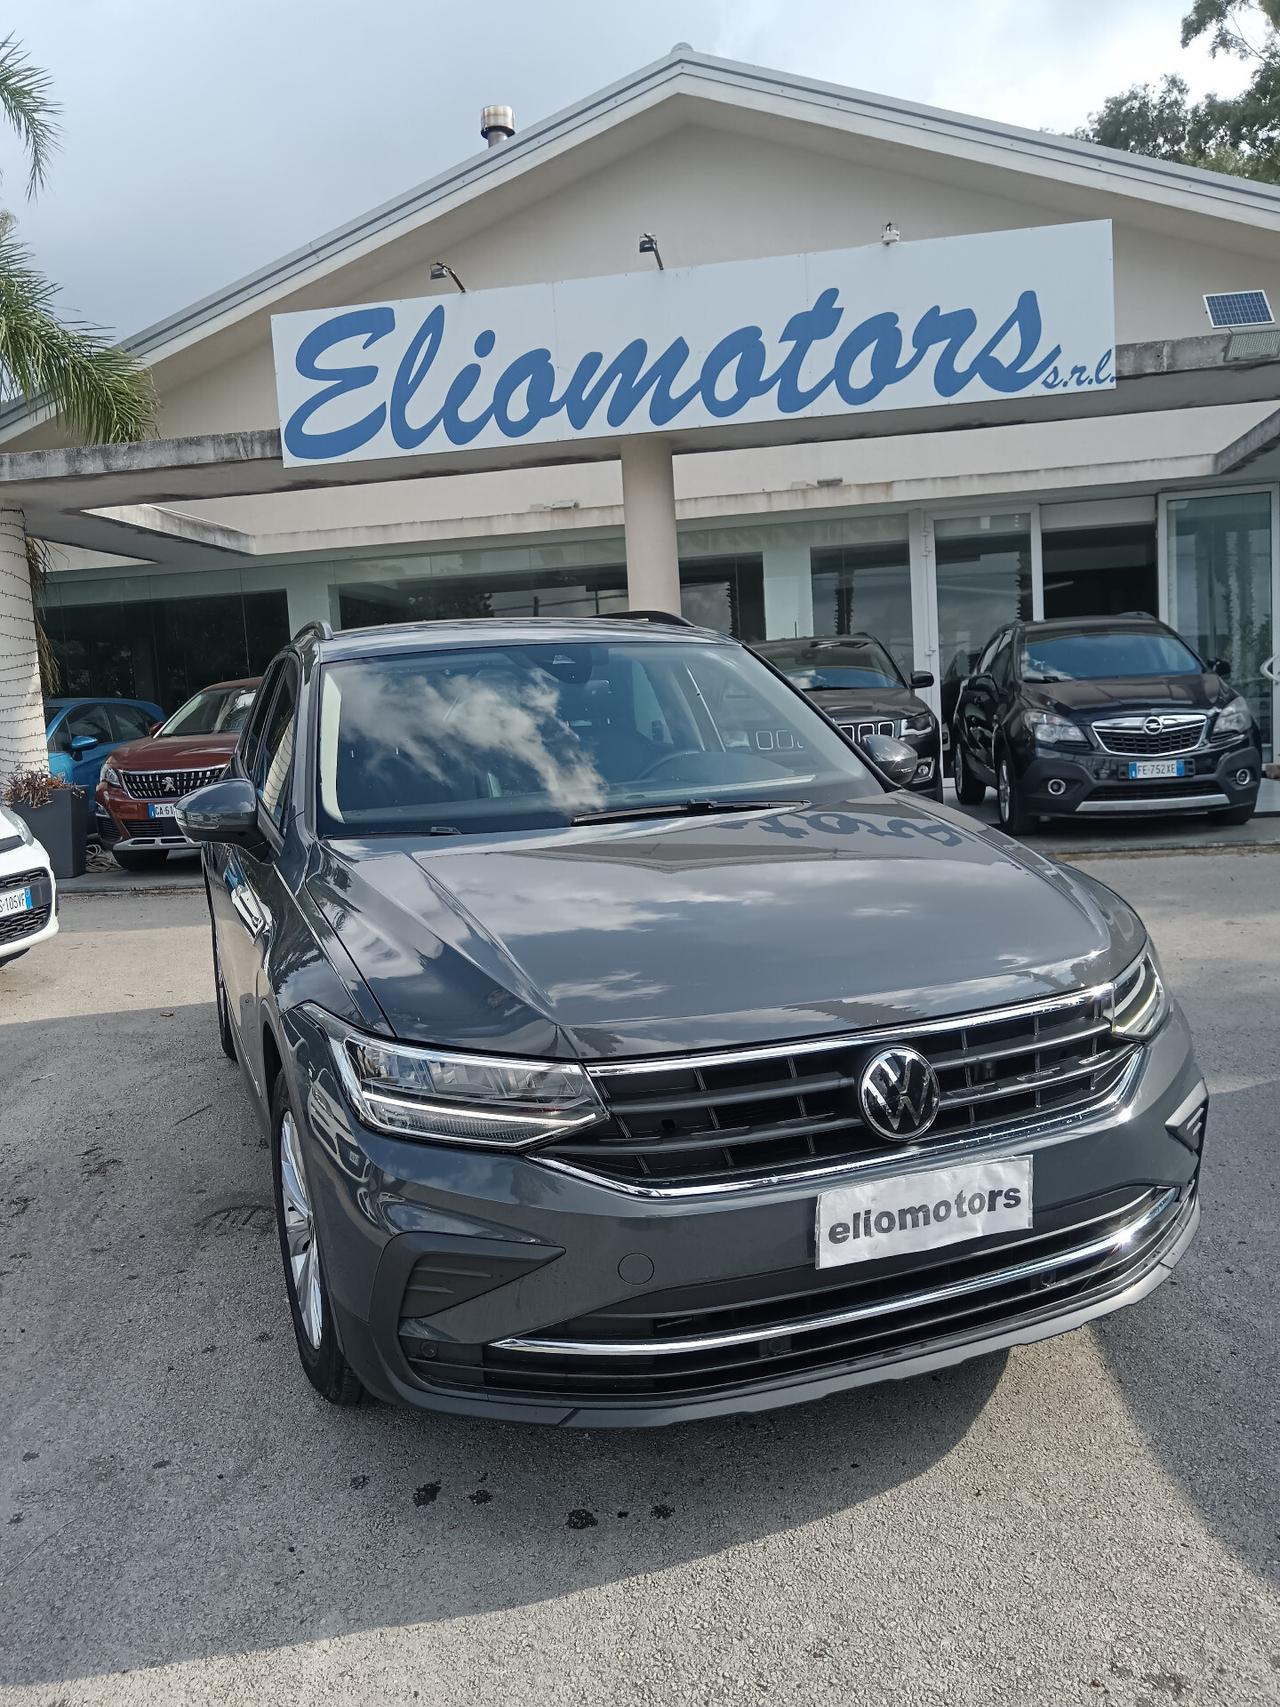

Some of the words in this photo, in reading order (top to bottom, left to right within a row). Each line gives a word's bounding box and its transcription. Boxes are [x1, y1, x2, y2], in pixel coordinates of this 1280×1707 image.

[284, 287, 1062, 460] Eliomotors
[1041, 347, 1116, 390] s.r.l.
[828, 1186, 1022, 1245] eliomotors
